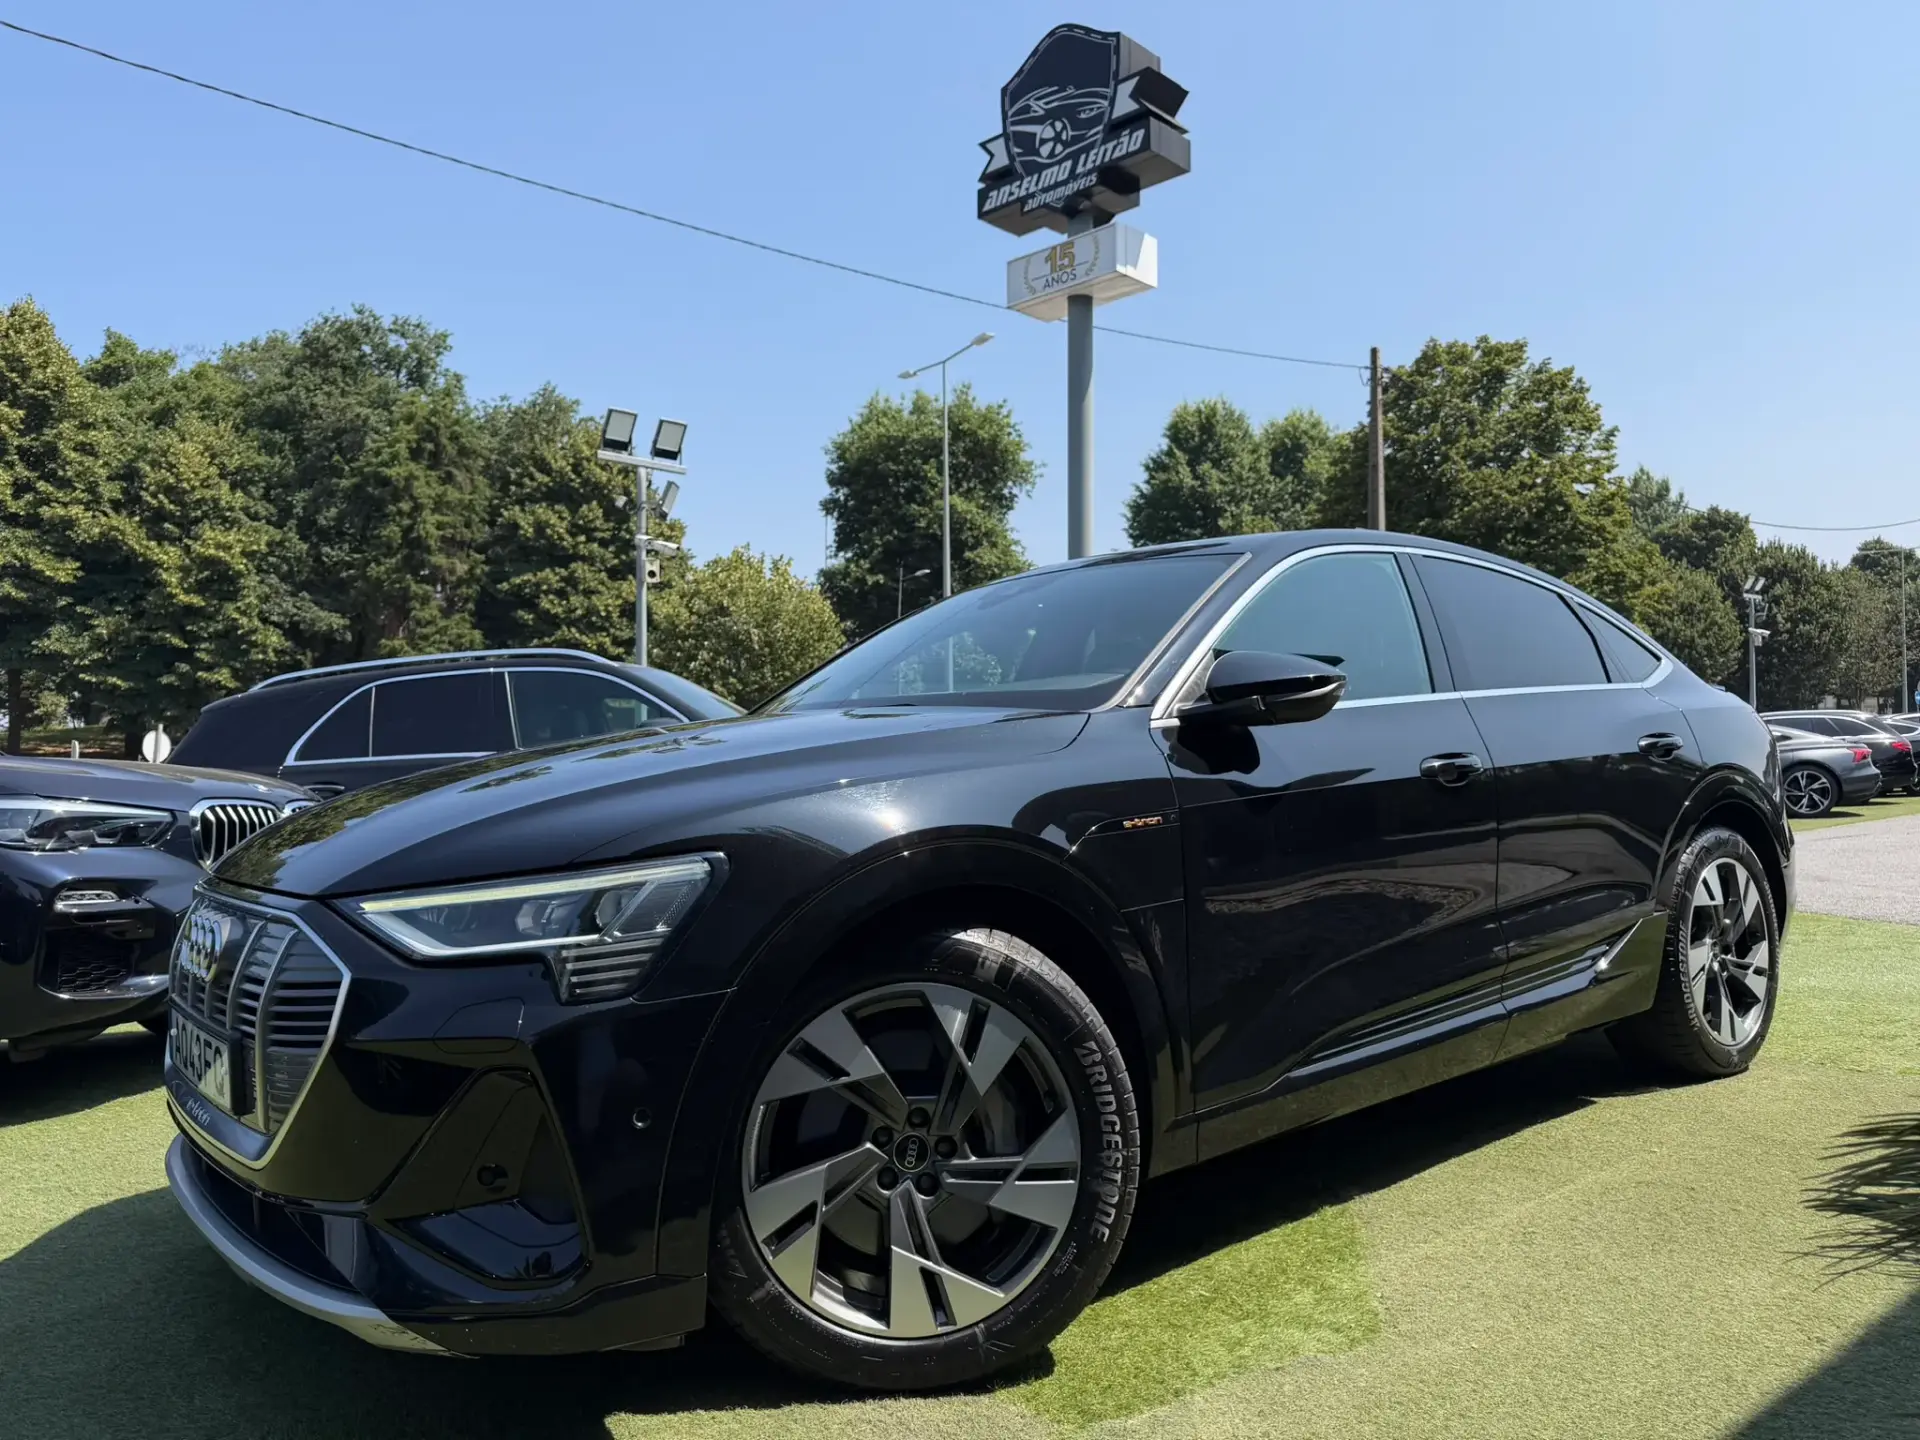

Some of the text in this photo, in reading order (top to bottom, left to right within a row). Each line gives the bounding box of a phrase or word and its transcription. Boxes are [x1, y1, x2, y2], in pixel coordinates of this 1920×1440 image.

[981, 128, 1146, 213] ANSELMO LEITÃO
[1043, 268, 1077, 292] ANOS
[1044, 241, 1076, 275] 15
[1074, 1040, 1123, 1243] BRIDGESTONE
